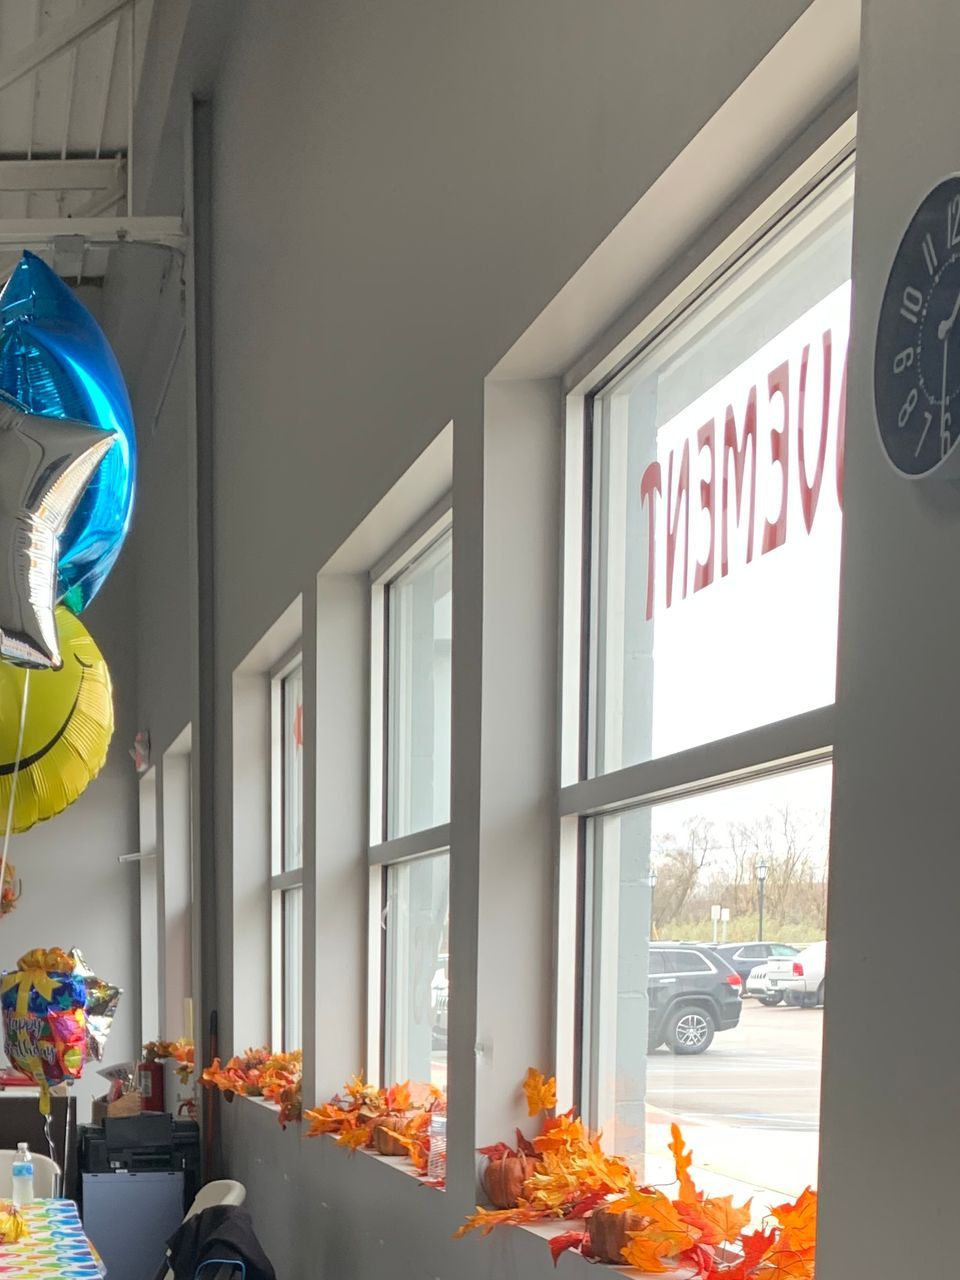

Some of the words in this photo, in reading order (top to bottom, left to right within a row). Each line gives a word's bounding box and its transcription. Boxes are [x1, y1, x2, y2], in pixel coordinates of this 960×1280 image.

[923, 233, 938, 276] 11
[900, 286, 923, 323] 10
[893, 347, 914, 374] 9
[897, 388, 918, 428] 8
[915, 411, 932, 458] 7
